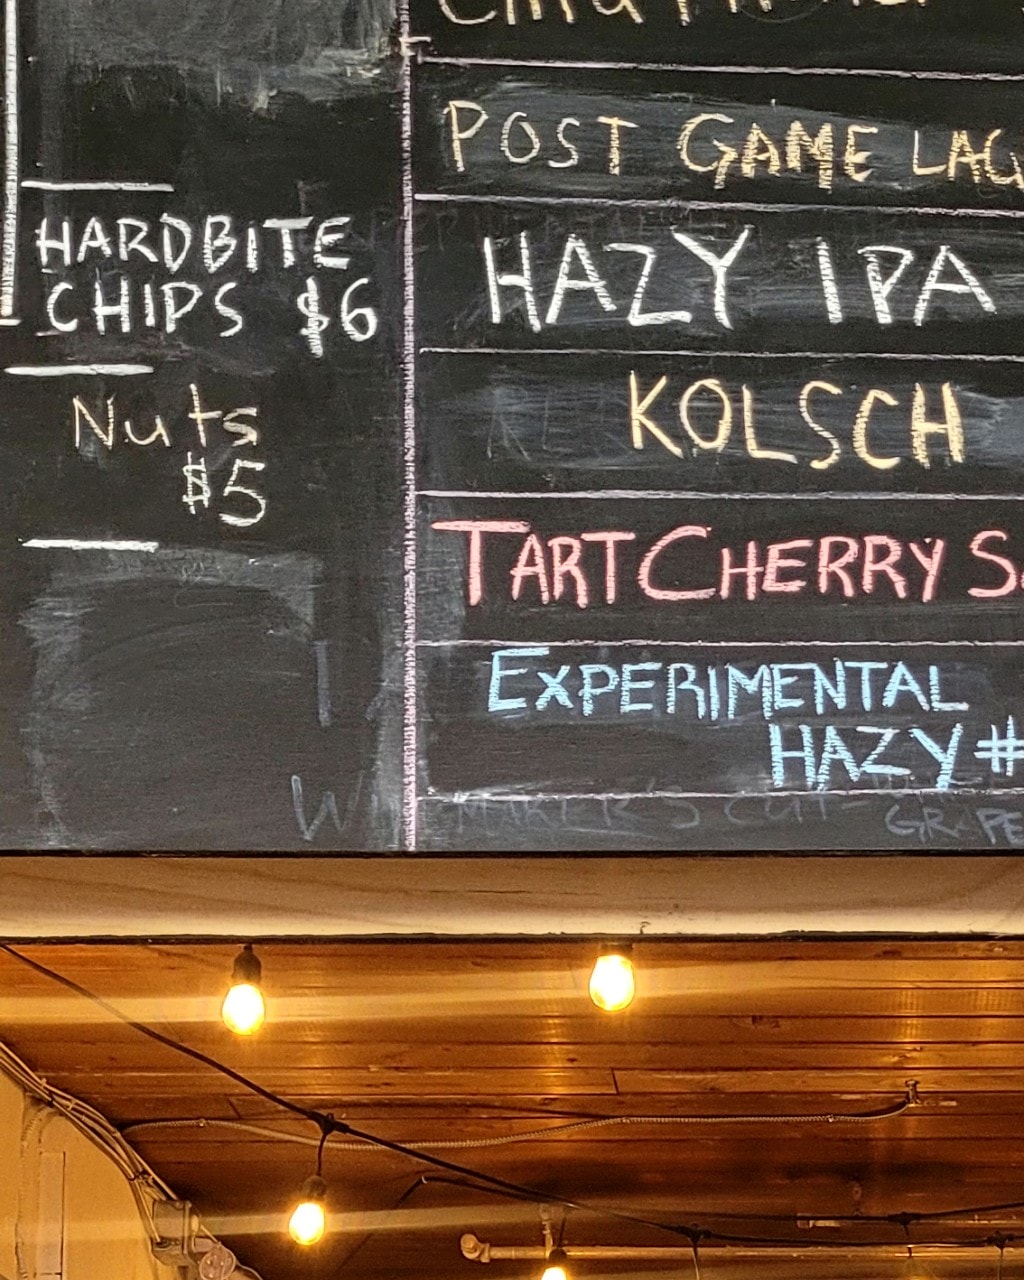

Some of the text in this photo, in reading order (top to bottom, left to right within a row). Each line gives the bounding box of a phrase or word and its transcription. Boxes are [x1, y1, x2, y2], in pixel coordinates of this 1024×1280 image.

[444, 100, 638, 176] POST
[677, 113, 877, 190] GAME
[36, 213, 351, 273] HARDBITE
[484, 224, 754, 333] HAZY
[816, 236, 997, 327] IPA
[46, 276, 377, 358] CHIPS $6
[630, 370, 964, 469] KOLSCH
[182, 452, 266, 526] $5
[431, 520, 635, 607] TART
[637, 524, 947, 602] CHERRY
[488, 647, 969, 720] EXPERIMENTAL
[769, 718, 963, 791] HAZY
